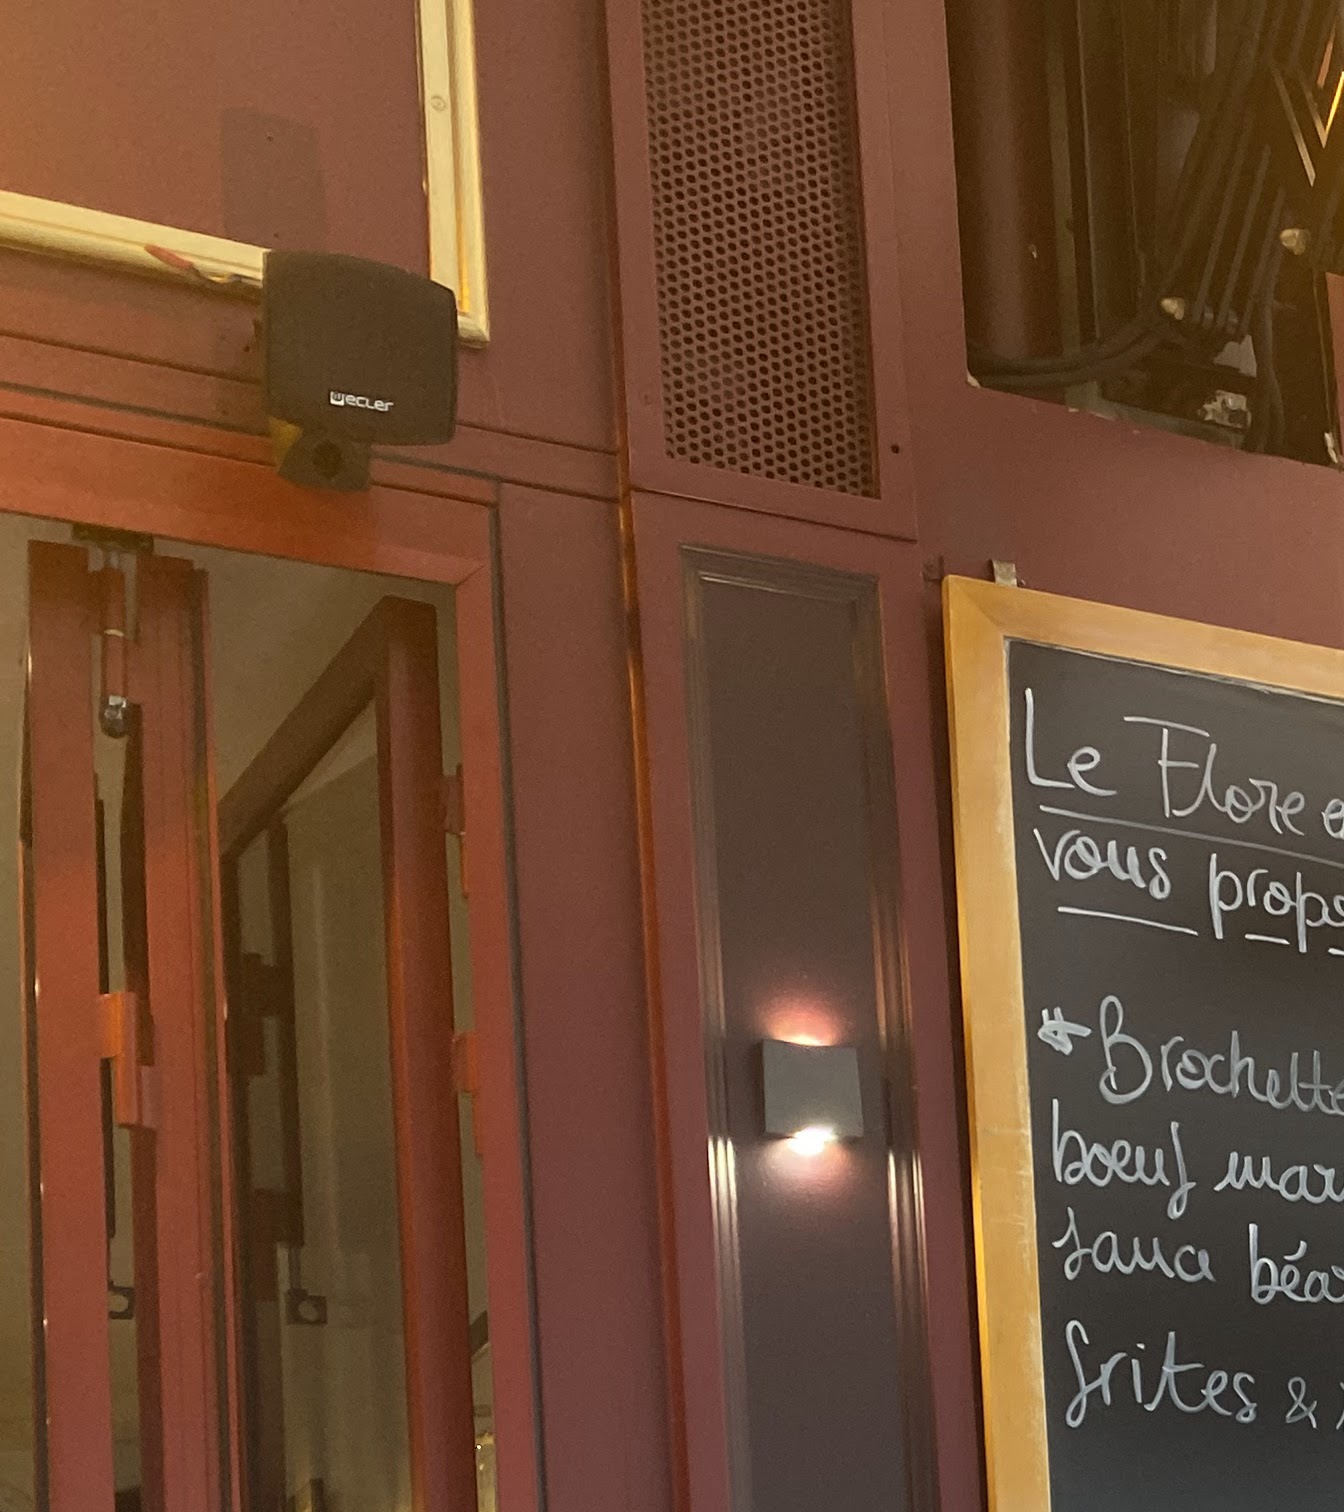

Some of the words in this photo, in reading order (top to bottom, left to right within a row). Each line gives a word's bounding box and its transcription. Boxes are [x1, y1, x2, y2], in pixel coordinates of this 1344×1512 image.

[1024, 688, 1116, 797] Le
[1124, 716, 1305, 836] Flore
[1033, 828, 1172, 900] vous
[1064, 1319, 1257, 1428] frites
[1285, 1376, 1318, 1429] &
